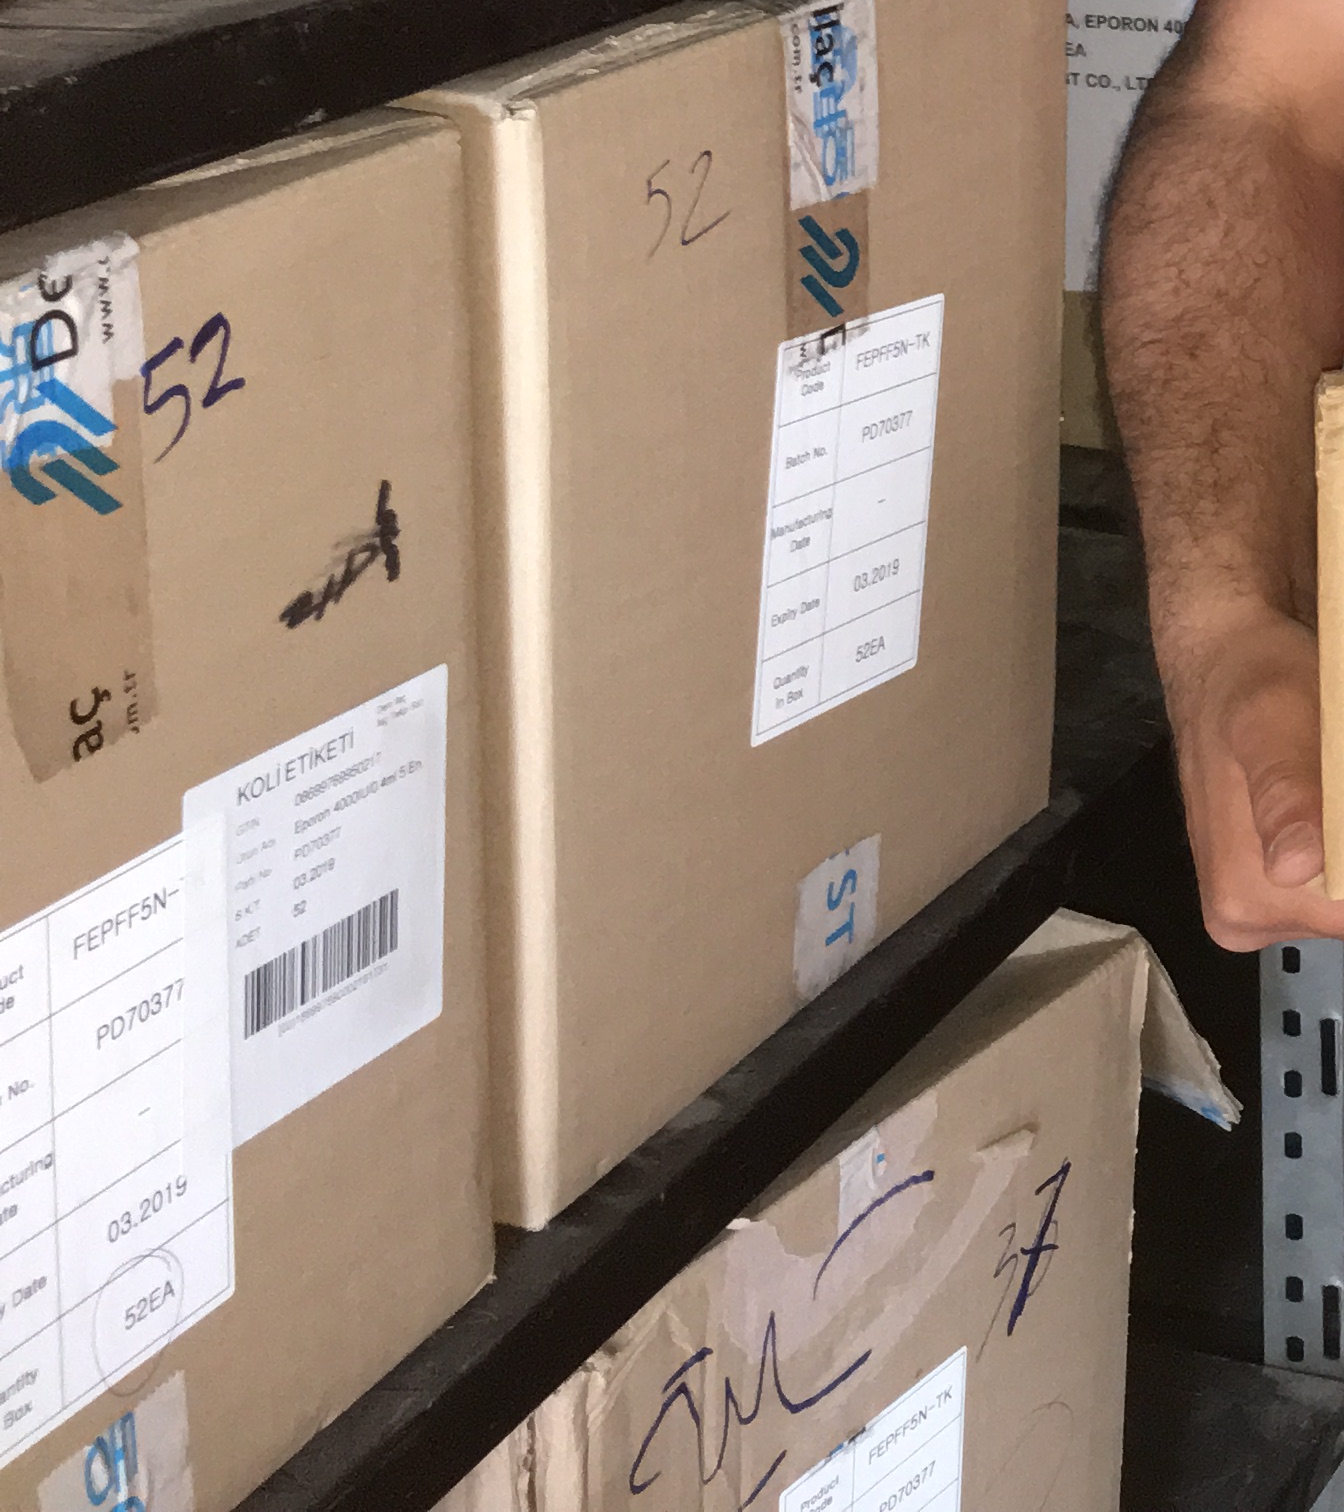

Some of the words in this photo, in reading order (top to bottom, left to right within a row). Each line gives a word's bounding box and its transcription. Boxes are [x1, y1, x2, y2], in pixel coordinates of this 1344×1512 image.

[1085, 14, 1159, 33] EPORON
[642, 147, 735, 258] 52
[855, 330, 931, 372] FEPFF5N-TK
[139, 310, 247, 466] 52
[801, 380, 825, 397] Code
[785, 450, 811, 470] Batch
[812, 445, 829, 459] No.
[861, 409, 913, 444] PD70377
[770, 507, 834, 540] Manufacturing
[790, 536, 811, 553] Date
[771, 608, 798, 628] Expiry
[799, 598, 821, 615] Date
[853, 558, 901, 593] 03.2019
[773, 664, 811, 690] Quantity
[855, 635, 886, 663] 52EA
[786, 689, 804, 705] Box
[236, 762, 281, 807] KOLİ
[284, 726, 355, 783] ETİKETİ
[825, 868, 858, 947] ST
[95, 976, 186, 1051] PD70377
[107, 1173, 188, 1244] 03.2019
[11, 1273, 48, 1308] Date
[124, 1280, 176, 1332] 52EA
[3, 1399, 33, 1431] Box
[801, 1474, 840, 1512] Product
[868, 1384, 953, 1465] FEPFF5N-TK
